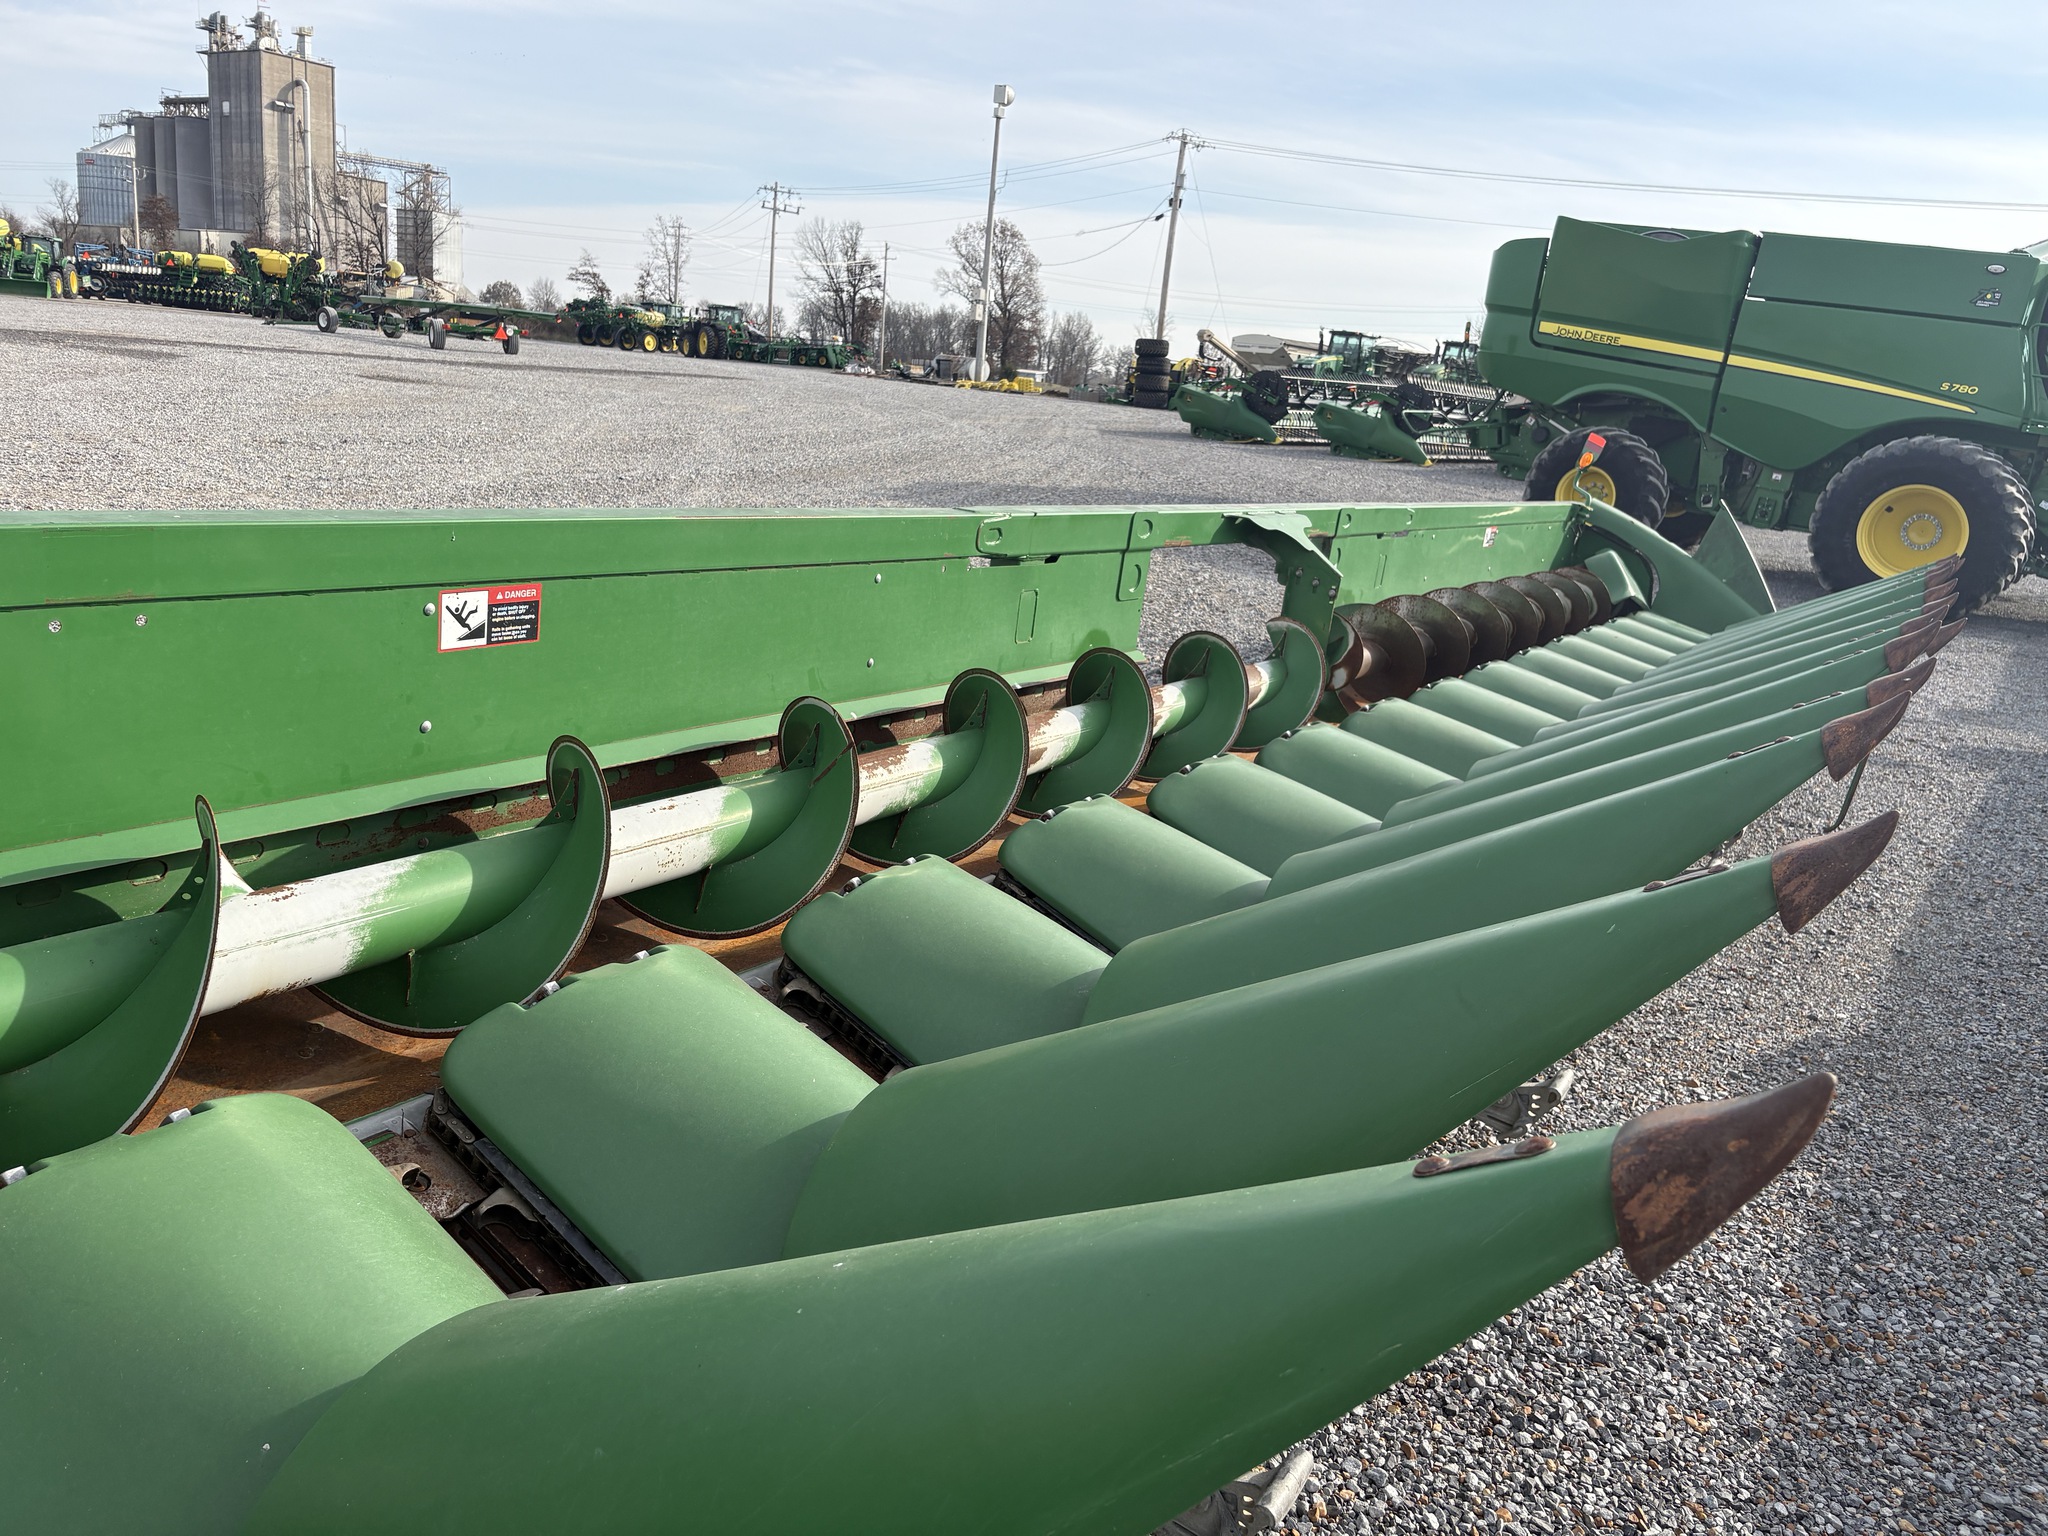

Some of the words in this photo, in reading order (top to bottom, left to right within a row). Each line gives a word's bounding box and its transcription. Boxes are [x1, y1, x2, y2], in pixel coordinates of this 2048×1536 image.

[1553, 326, 1582, 338] JOHN
[1584, 330, 1621, 344] DEERE
[504, 589, 536, 598] DANGER
